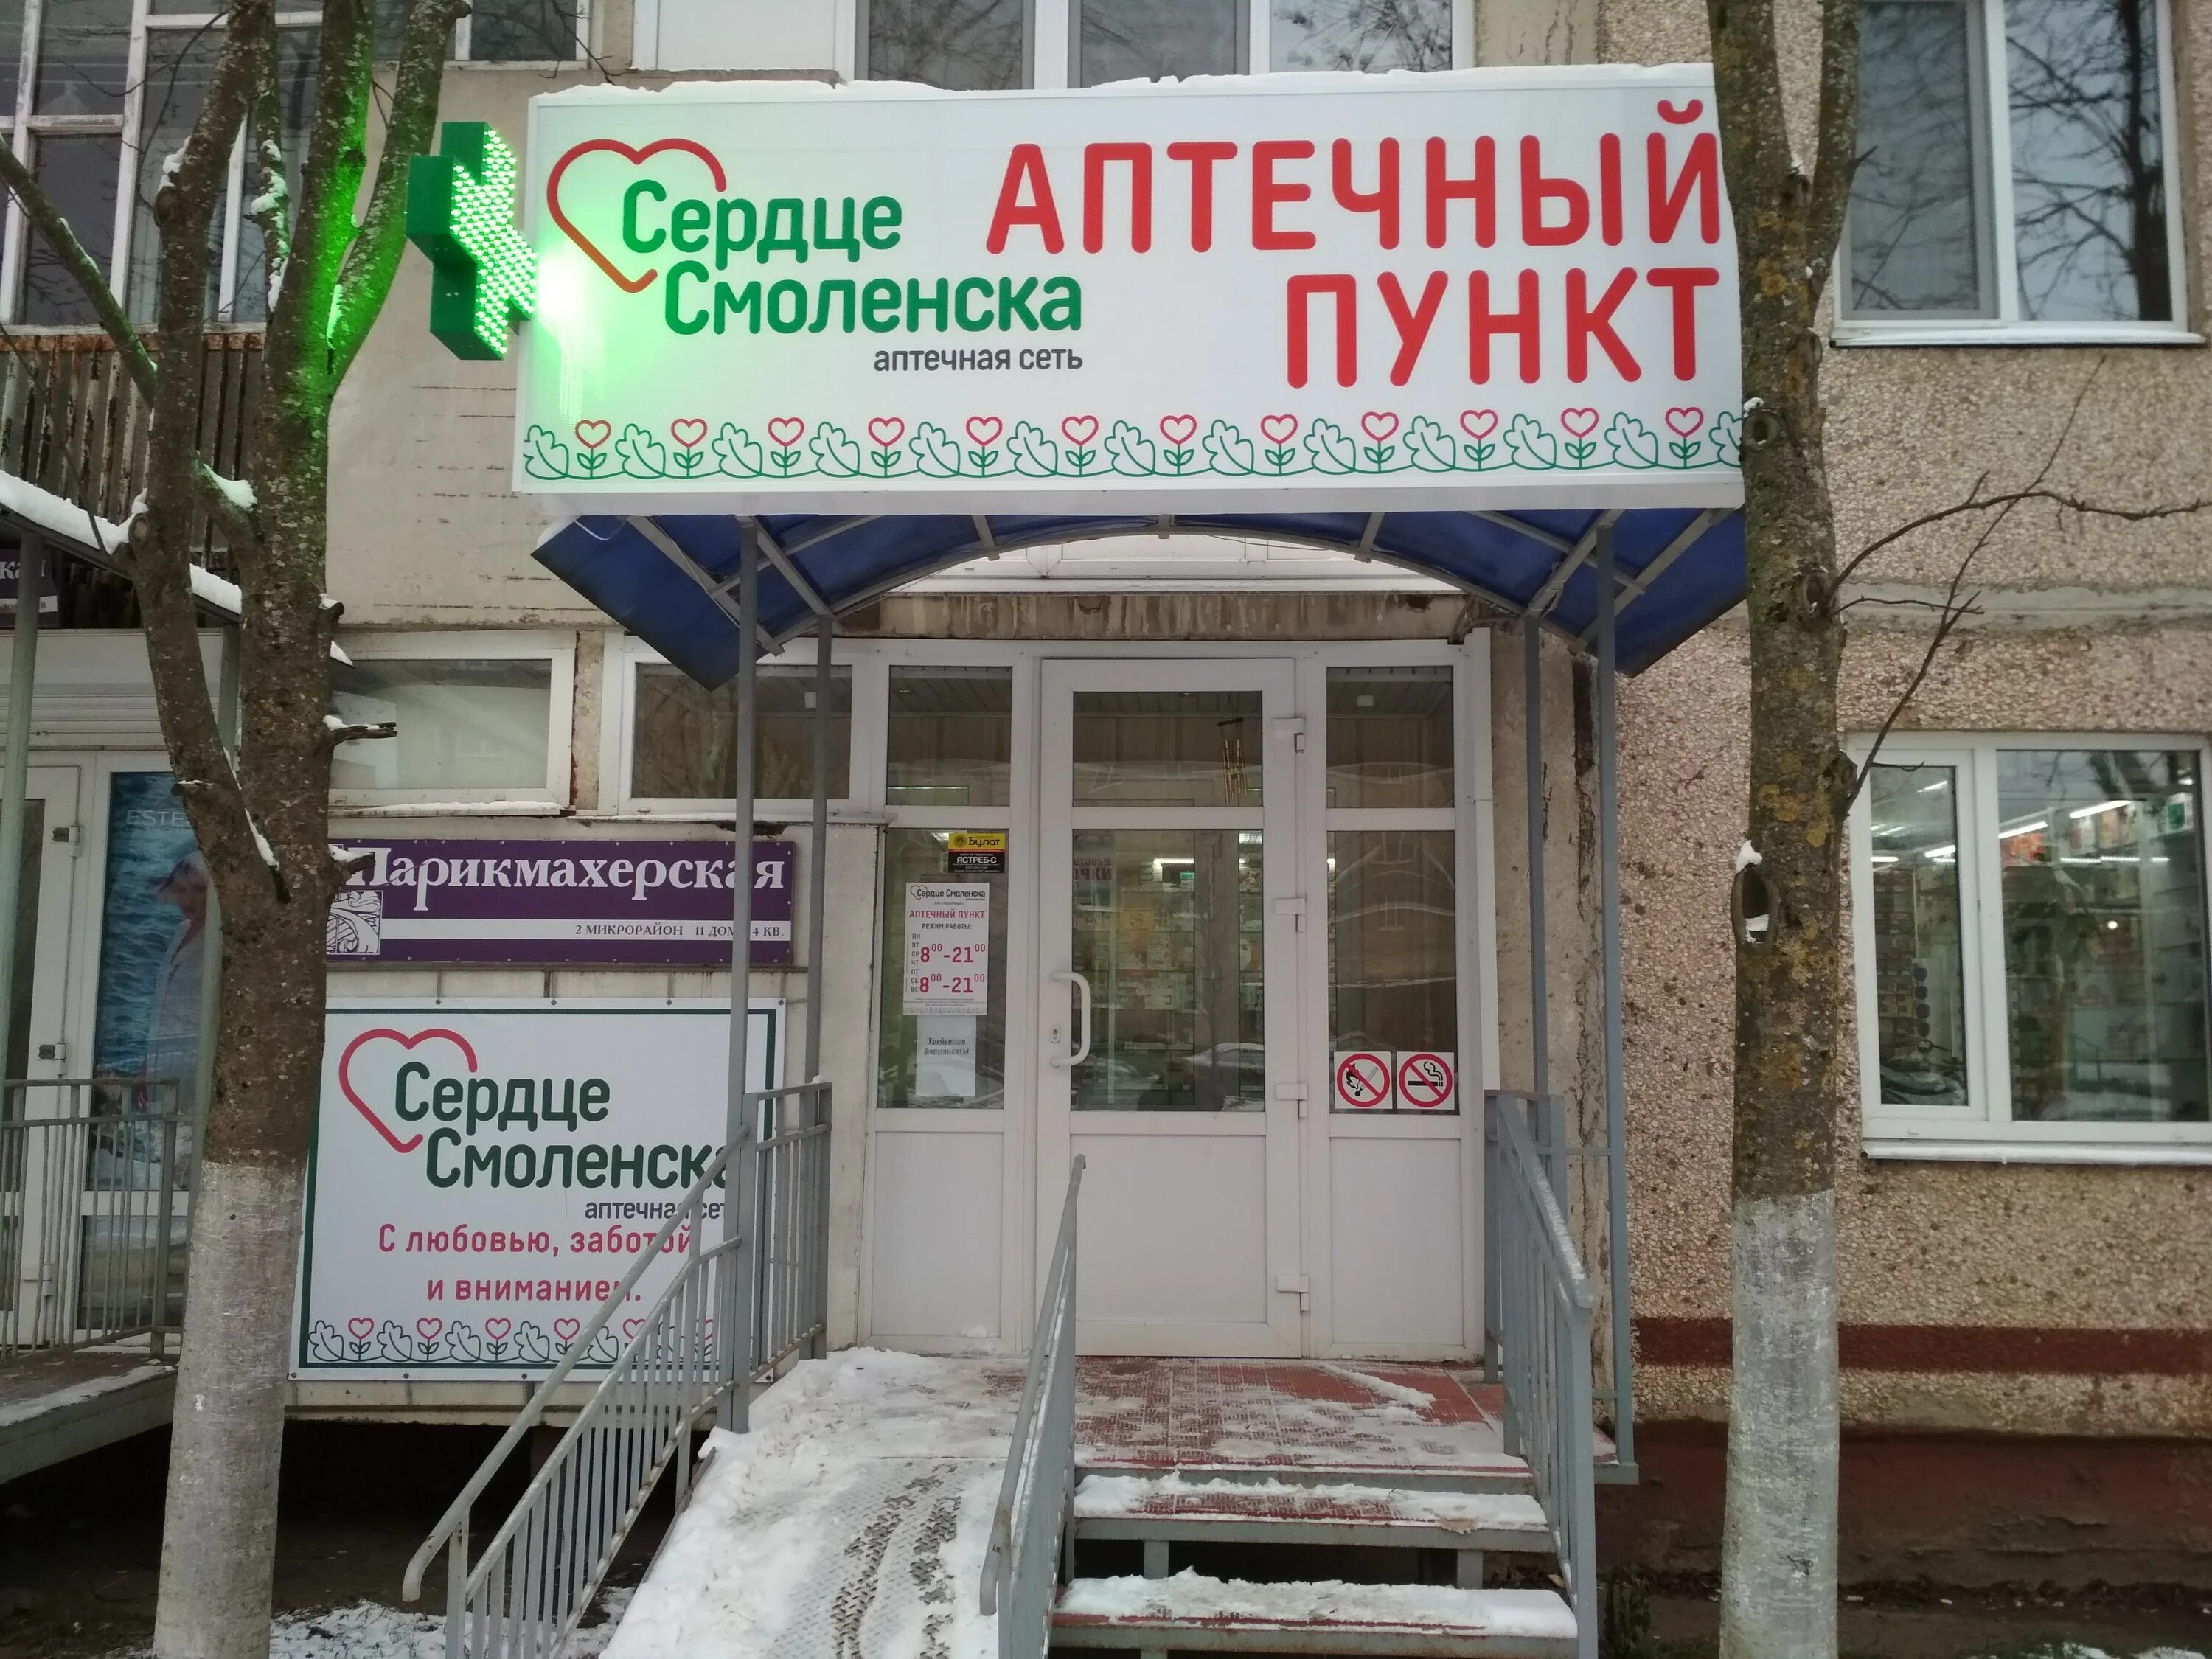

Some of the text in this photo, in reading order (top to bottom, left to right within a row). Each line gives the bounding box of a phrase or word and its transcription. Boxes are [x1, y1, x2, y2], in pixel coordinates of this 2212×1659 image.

[985, 99, 1720, 254] АПТЕЧНЫЙ
[622, 178, 903, 271] Сердце
[664, 260, 1082, 335] Смоленска
[1287, 266, 1720, 389] ПУНКТ
[874, 348, 1083, 372] аптечная сеть
[127, 810, 191, 827] ESTE
[968, 837, 1001, 847] Булат
[917, 888, 985, 898] Сердце Смоленска
[909, 908, 956, 918] АПТЕЧНЫЙ
[575, 925, 582, 935] 2
[586, 922, 684, 936] МИКРОРАЙОН
[695, 927, 705, 936] 11
[395, 1062, 610, 1136] Сердце
[585, 1202, 691, 1219] аптечна
[379, 1224, 395, 1252] С
[406, 1224, 559, 1257] любовью,
[427, 1279, 444, 1301] и
